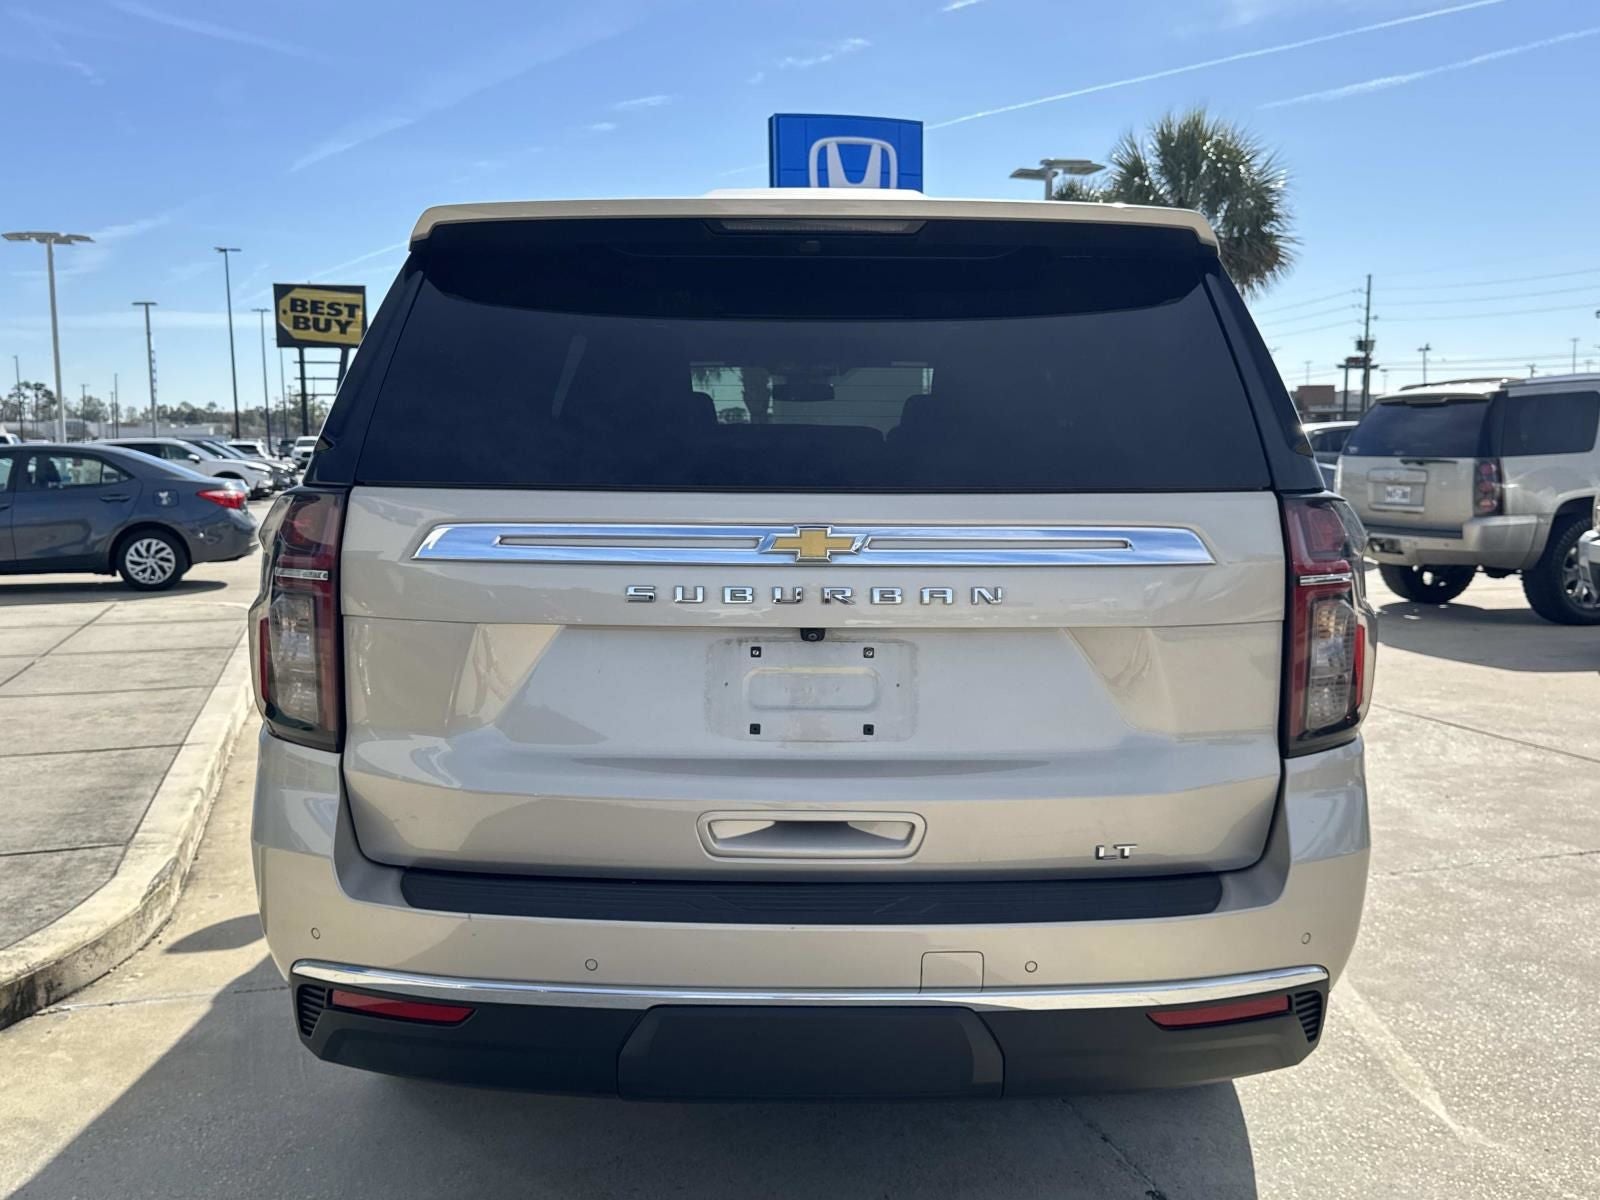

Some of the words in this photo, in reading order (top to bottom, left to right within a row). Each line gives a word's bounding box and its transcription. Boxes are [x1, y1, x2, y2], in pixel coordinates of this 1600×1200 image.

[290, 297, 360, 319] BEST
[292, 315, 354, 335] BUY
[625, 584, 1004, 606] SUBURBAN
[1095, 844, 1138, 860] LT
